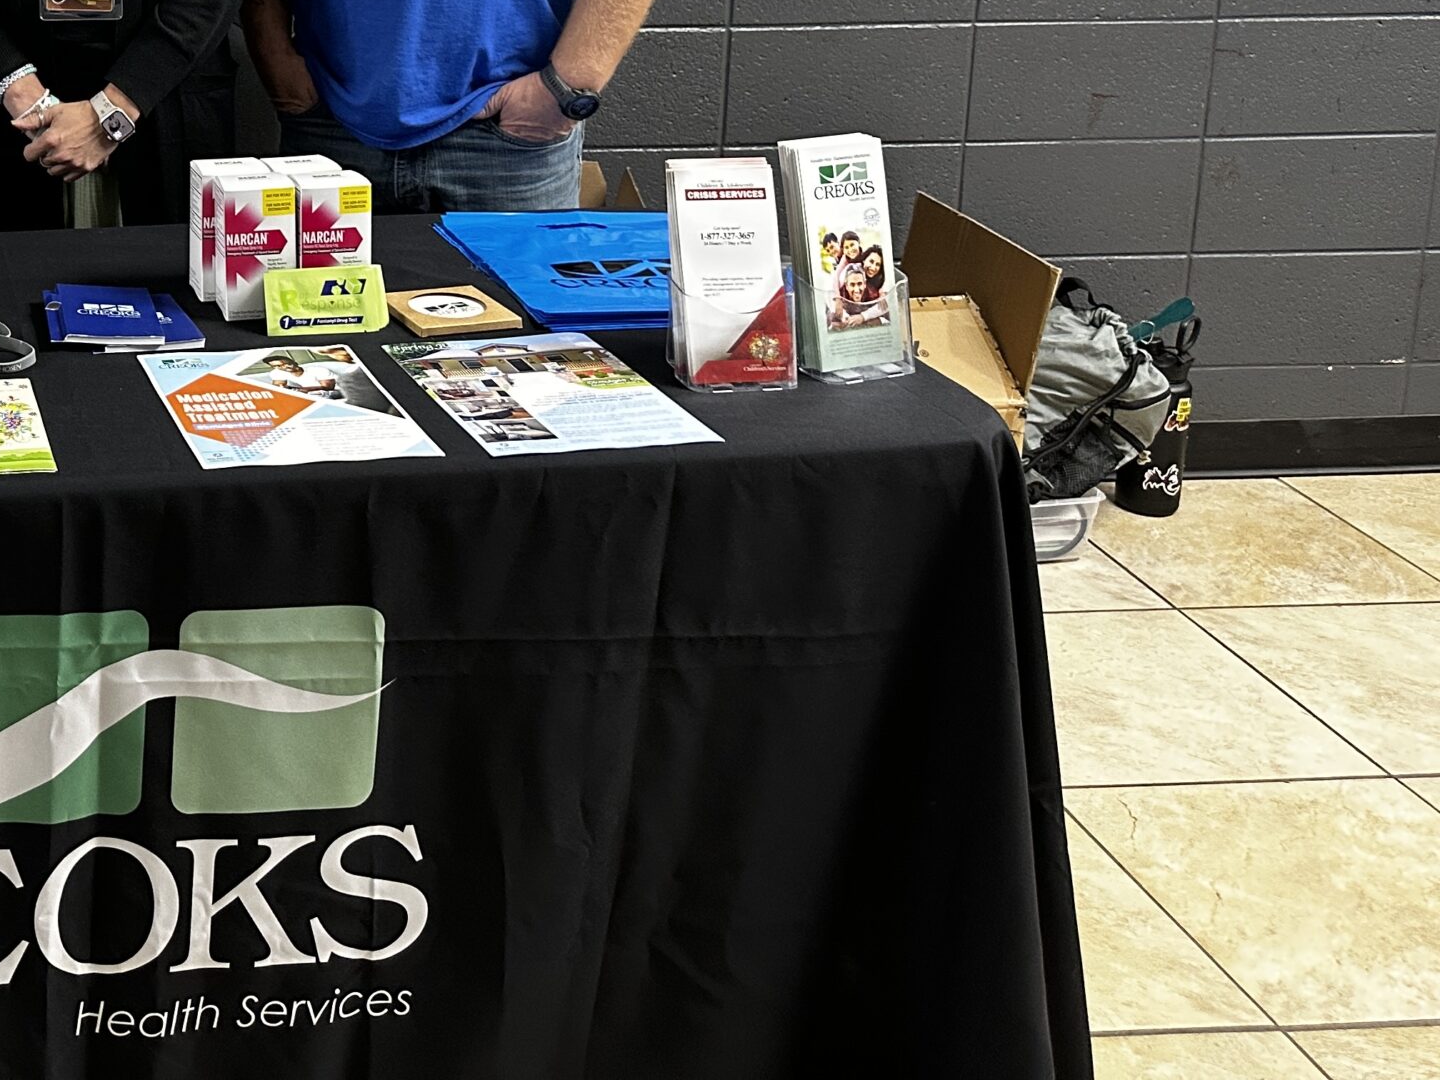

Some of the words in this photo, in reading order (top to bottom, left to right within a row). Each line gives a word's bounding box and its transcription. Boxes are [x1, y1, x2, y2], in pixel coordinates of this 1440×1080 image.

[687, 190, 718, 199] CRISIS
[719, 190, 764, 198] SERVICES
[814, 181, 875, 200] CREOKS
[226, 233, 268, 246] NARCAN
[303, 230, 344, 244] NARCAN
[700, 232, 755, 240] 1-877-327-3657
[550, 278, 670, 290] CREO
[76, 309, 141, 317] CREOKS
[282, 317, 290, 329] 1
[176, 390, 274, 403] Medication
[182, 400, 257, 413] Assisted
[186, 409, 279, 423] Treatment
[74, 996, 221, 1038] Health
[235, 986, 413, 1029] Services
